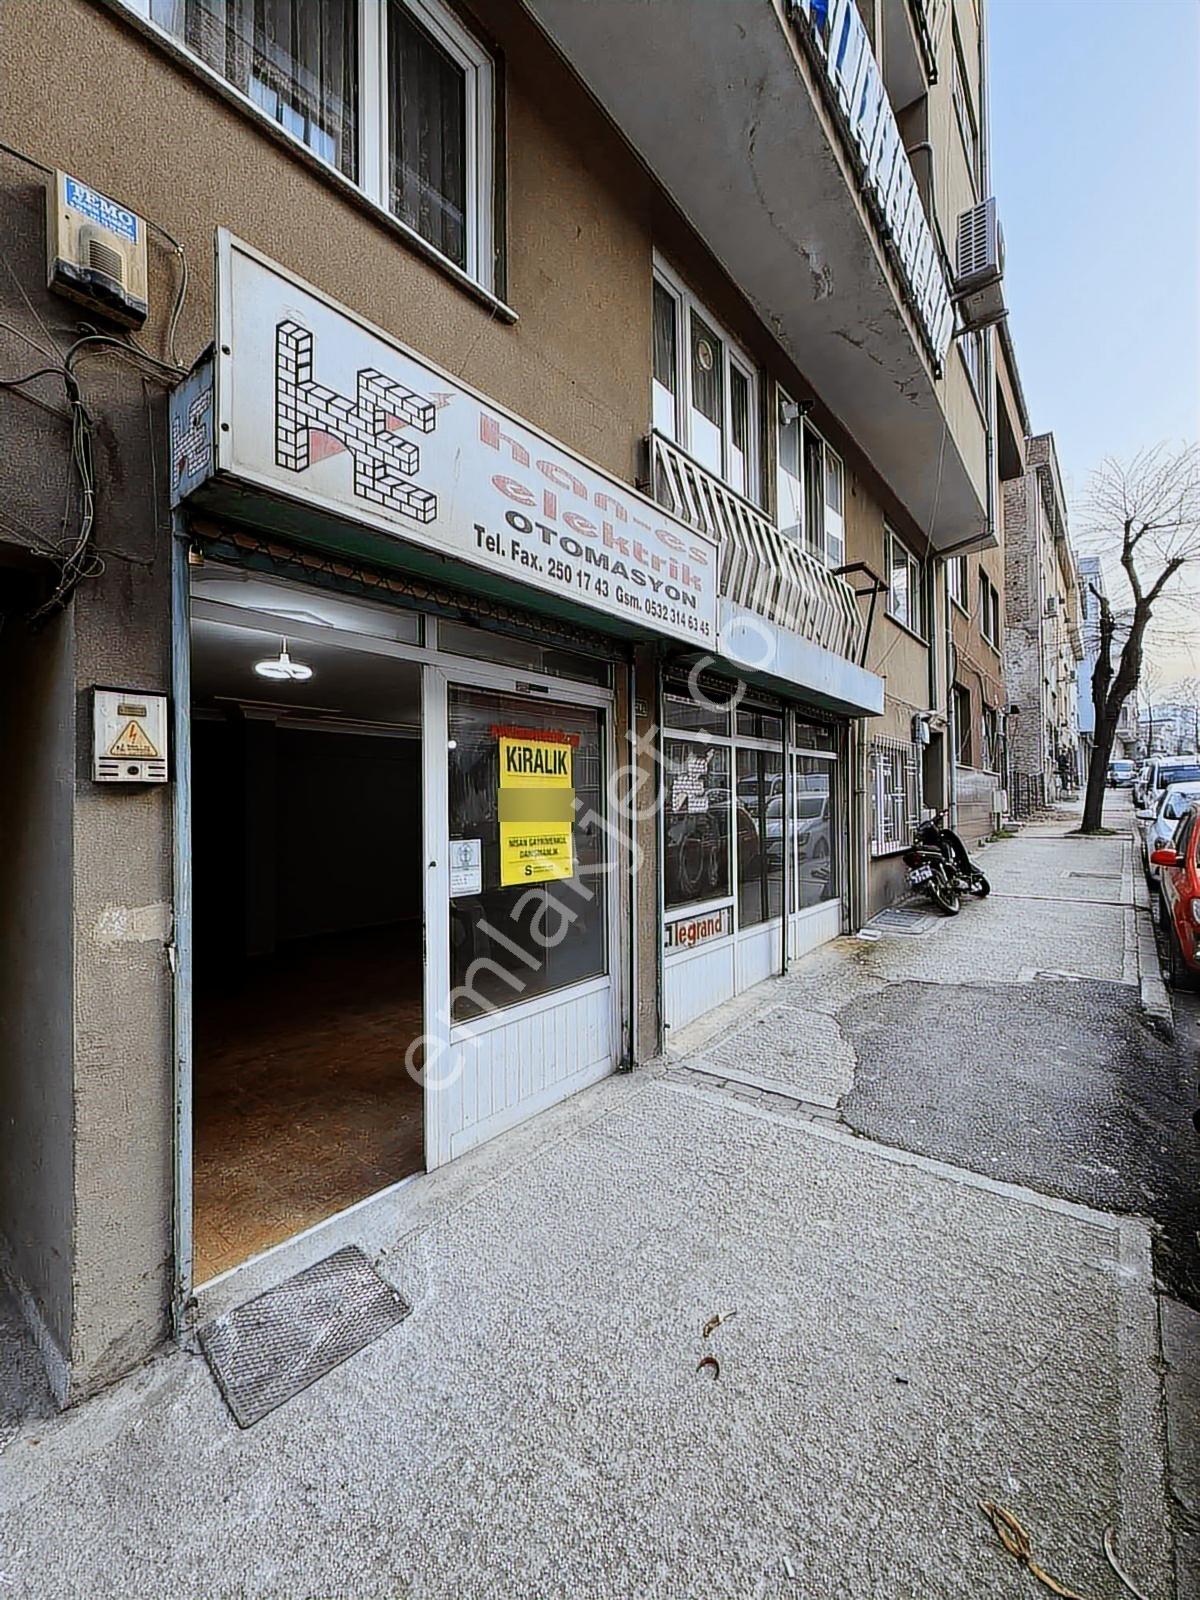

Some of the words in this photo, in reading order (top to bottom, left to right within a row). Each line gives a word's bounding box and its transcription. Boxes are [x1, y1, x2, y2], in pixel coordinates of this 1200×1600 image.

[473, 523, 506, 557] Tel.
[511, 539, 543, 572] Fax.
[547, 557, 573, 584] 250
[576, 569, 591, 591] 17
[594, 578, 609, 598] 43
[615, 585, 643, 611] Gsm.
[644, 598, 669, 621] 0532
[670, 608, 686, 628] 314
[687, 615, 698, 632] 63
[700, 621, 710, 637] 45
[491, 473, 702, 593] elektrik
[504, 510, 697, 610] OTOMASYON
[674, 909, 723, 948] legrand
